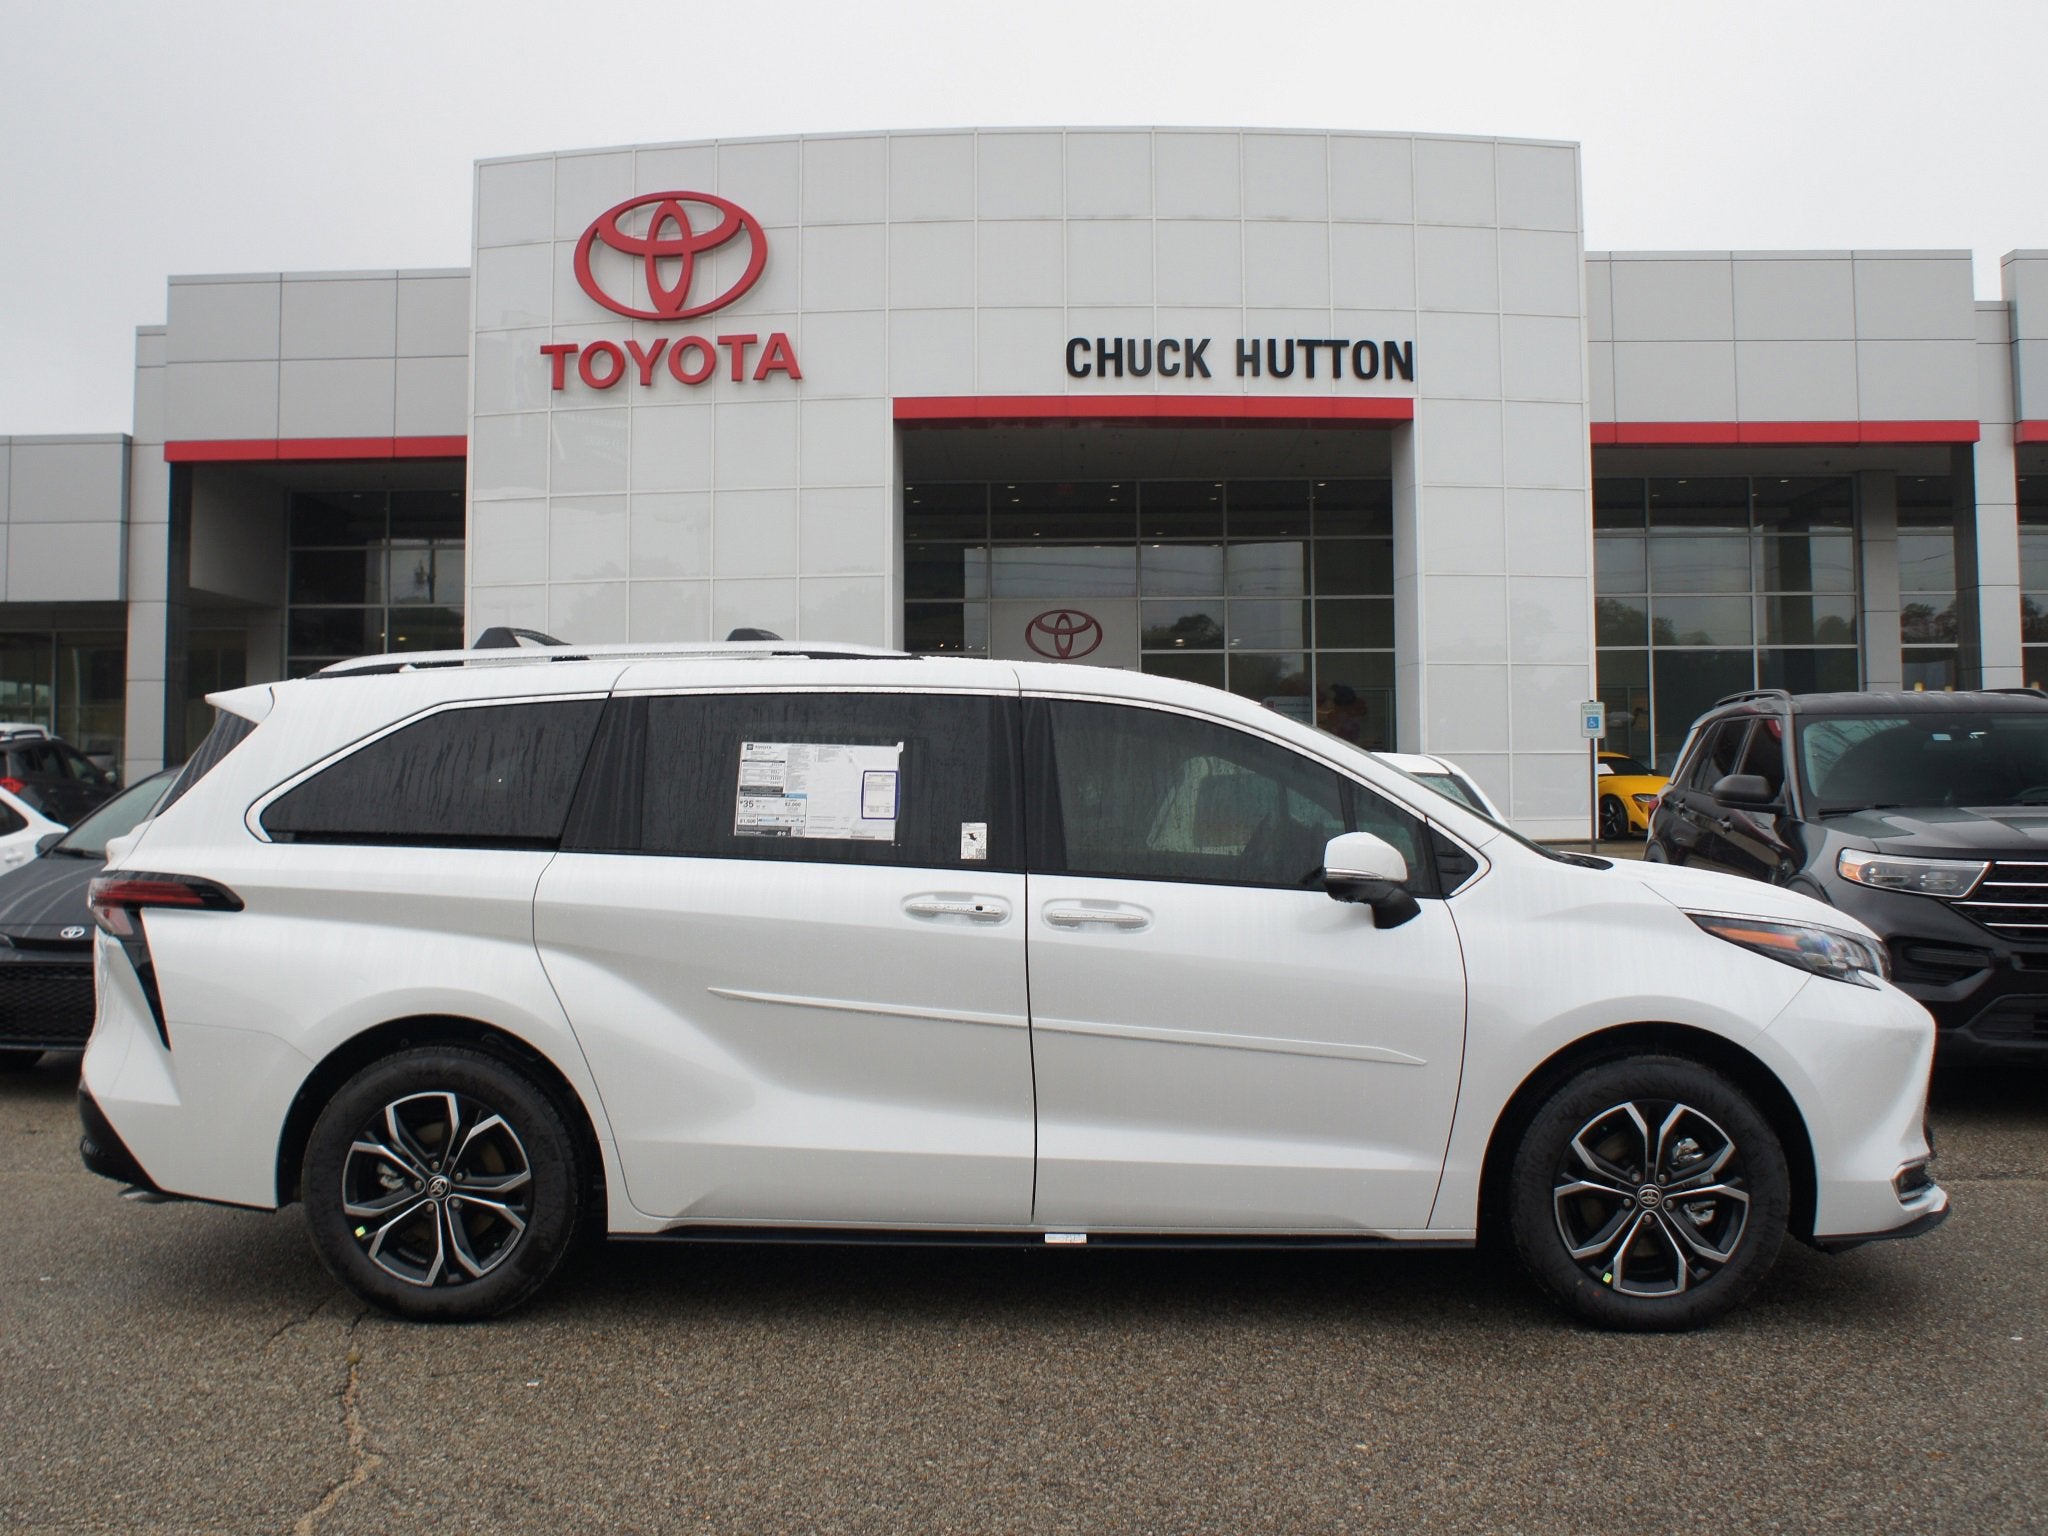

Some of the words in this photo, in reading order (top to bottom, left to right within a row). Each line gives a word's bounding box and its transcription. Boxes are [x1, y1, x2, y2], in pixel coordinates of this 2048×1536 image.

[540, 333, 802, 390] TOYOTA
[1065, 337, 1212, 379] CHUCK
[1236, 338, 1414, 382] HUTTON
